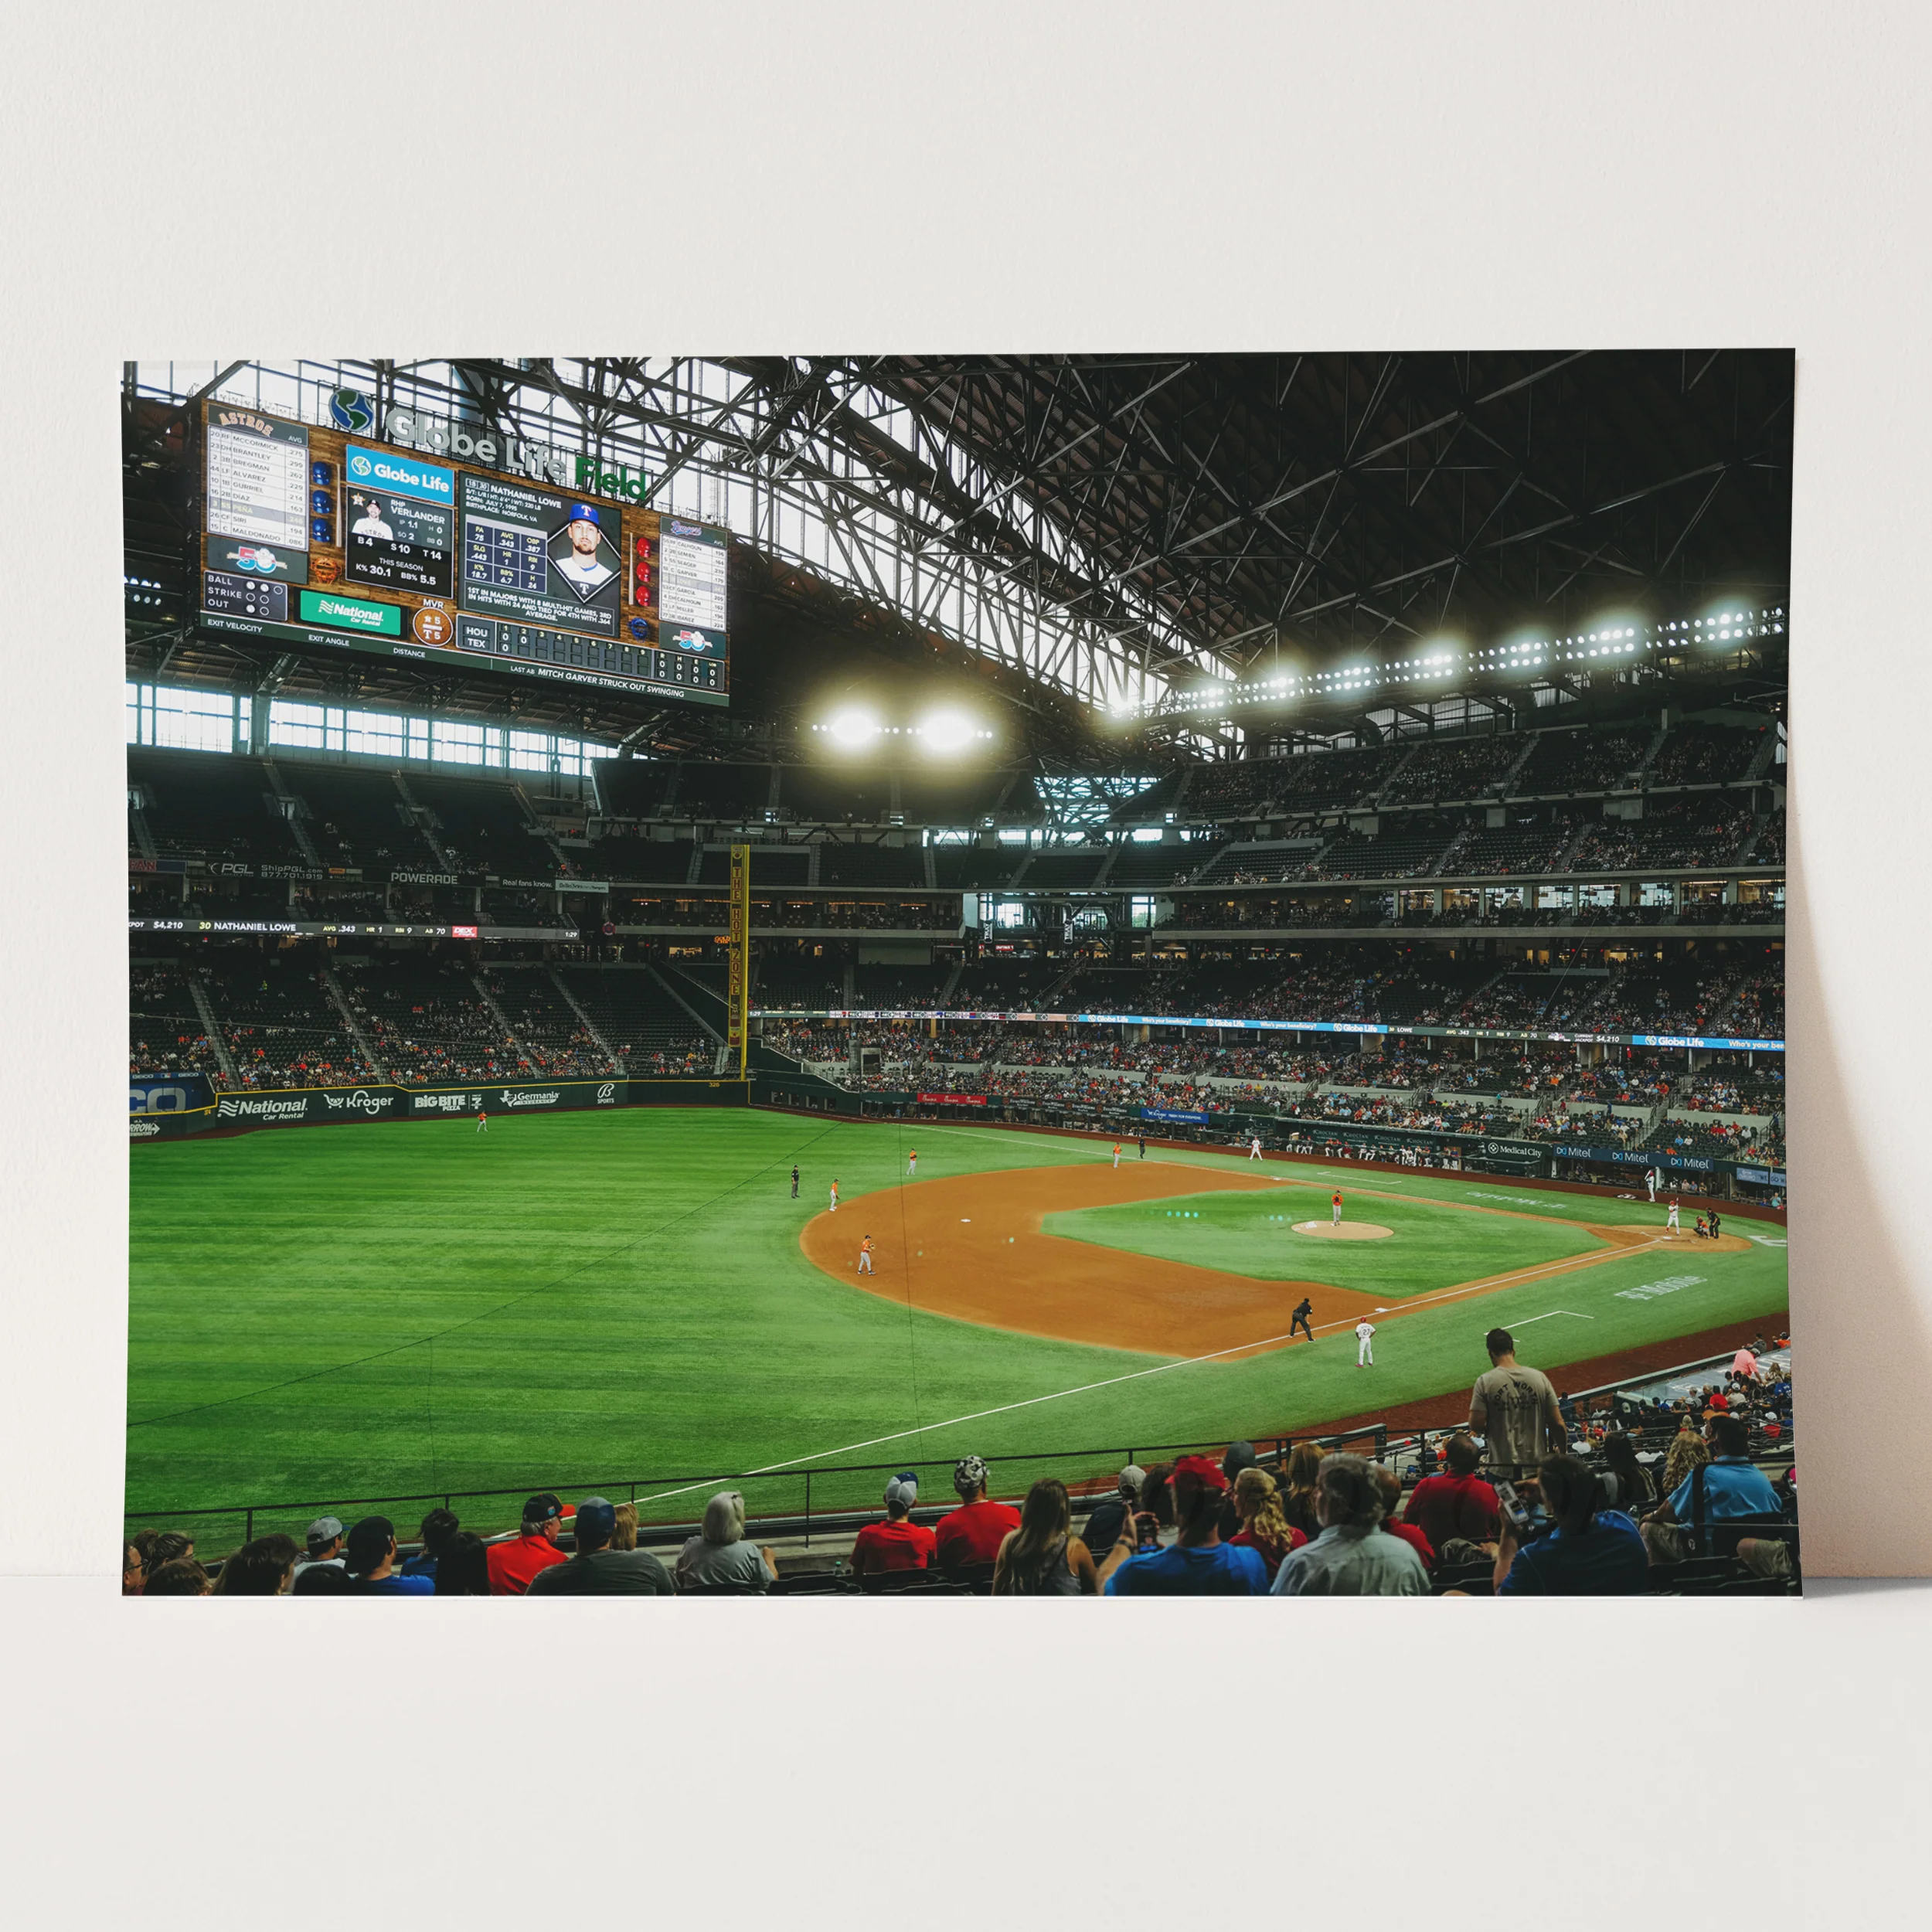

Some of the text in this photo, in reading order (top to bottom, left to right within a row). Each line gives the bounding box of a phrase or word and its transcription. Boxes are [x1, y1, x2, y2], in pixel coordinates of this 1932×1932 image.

[219, 412, 274, 437] ASTROS
[233, 436, 278, 451] MCCORMICK
[288, 435, 302, 444] AVG
[233, 447, 271, 460] BRANTLEY
[386, 407, 647, 501] Globe Life Field
[233, 457, 270, 471] BREGMAN
[233, 470, 266, 482] ALVAREZ
[374, 464, 450, 492] Globe Life
[233, 481, 263, 493] GURRIEL
[391, 499, 406, 507] RHP
[491, 485, 562, 509] NATHANIEL LOWE
[391, 506, 445, 525] VERLANDER
[408, 520, 418, 529] 1.1
[233, 527, 281, 542] MALDONADO
[501, 532, 514, 540] AVG
[365, 537, 373, 547] 4
[399, 544, 410, 554] 10
[430, 551, 442, 560] 14
[379, 558, 423, 571] THIS SEASON
[208, 575, 232, 585] BALL
[370, 565, 391, 577] 30.1
[420, 575, 436, 585] 5.5
[471, 571, 487, 579] 18.7
[208, 587, 242, 599] STRIKE
[468, 586, 479, 594] 1ST
[490, 590, 518, 601] MAJORS
[519, 596, 536, 605] WITH
[542, 601, 574, 612] MULTI-HIT
[208, 599, 229, 609] OUT
[423, 599, 444, 609] MVR
[494, 599, 512, 607] WITH
[522, 603, 537, 612] AND
[580, 614, 598, 623] WITH
[466, 627, 488, 637] HOU
[207, 619, 425, 658] EXIT VELOCITY EXIT ANGLE DISTANCE
[467, 638, 486, 648] TEX
[538, 668, 564, 679] MITCH
[565, 672, 597, 685] GARVER
[599, 678, 628, 689] STRUCK
[629, 683, 646, 692] OUT
[646, 685, 685, 698] SWINGING
[221, 863, 254, 874] PGL
[261, 864, 323, 874] ShipPGL.com
[391, 872, 457, 885] POWERADE
[733, 866, 742, 902] THE
[153, 921, 183, 930] $4,210
[199, 922, 211, 930] 30
[214, 922, 268, 932] NATHANIEL
[269, 923, 296, 932] LOWE
[732, 908, 741, 943] HOT
[731, 950, 741, 995] ZONE
[1344, 1024, 1363, 1032] Globe
[1596, 1035, 1619, 1043] $4,210
[1658, 1036, 1704, 1047] Globe Life
[439, 1095, 466, 1107] BITE
[518, 1091, 559, 1100] Germania
[346, 1090, 394, 1115] Kroger
[279, 1112, 304, 1120] Rental
[1500, 1145, 1543, 1157] Medical City
[1568, 1147, 1591, 1158] Mitel
[1624, 1152, 1649, 1163] Mitel
[1684, 1157, 1709, 1169] Mitel
